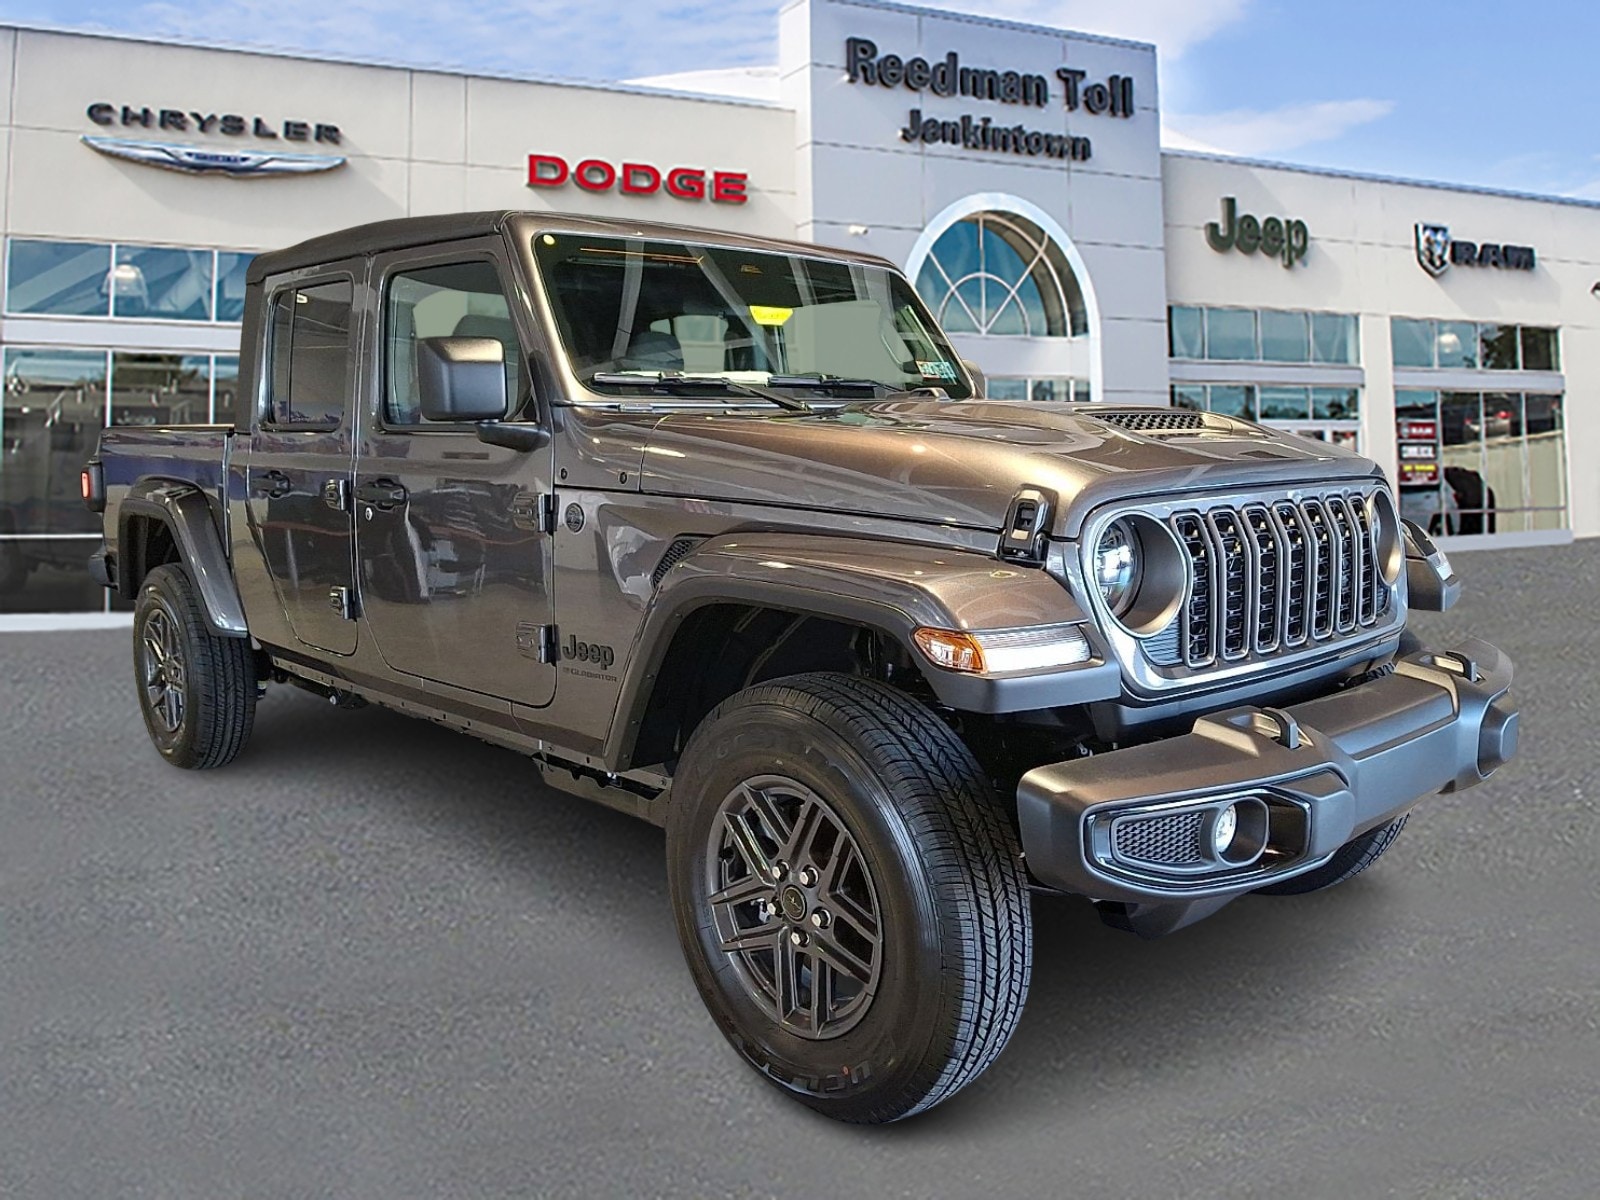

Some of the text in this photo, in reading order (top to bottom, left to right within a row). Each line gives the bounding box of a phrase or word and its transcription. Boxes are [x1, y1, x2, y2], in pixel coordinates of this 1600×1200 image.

[845, 37, 1134, 118] Reedman Toll
[86, 102, 342, 145] CHRYSLER
[901, 109, 1092, 161] Jenkintown
[527, 154, 749, 205] DODGE
[1204, 197, 1308, 269] Jeep
[1450, 240, 1536, 270] RAM
[562, 634, 614, 670] Jeep
